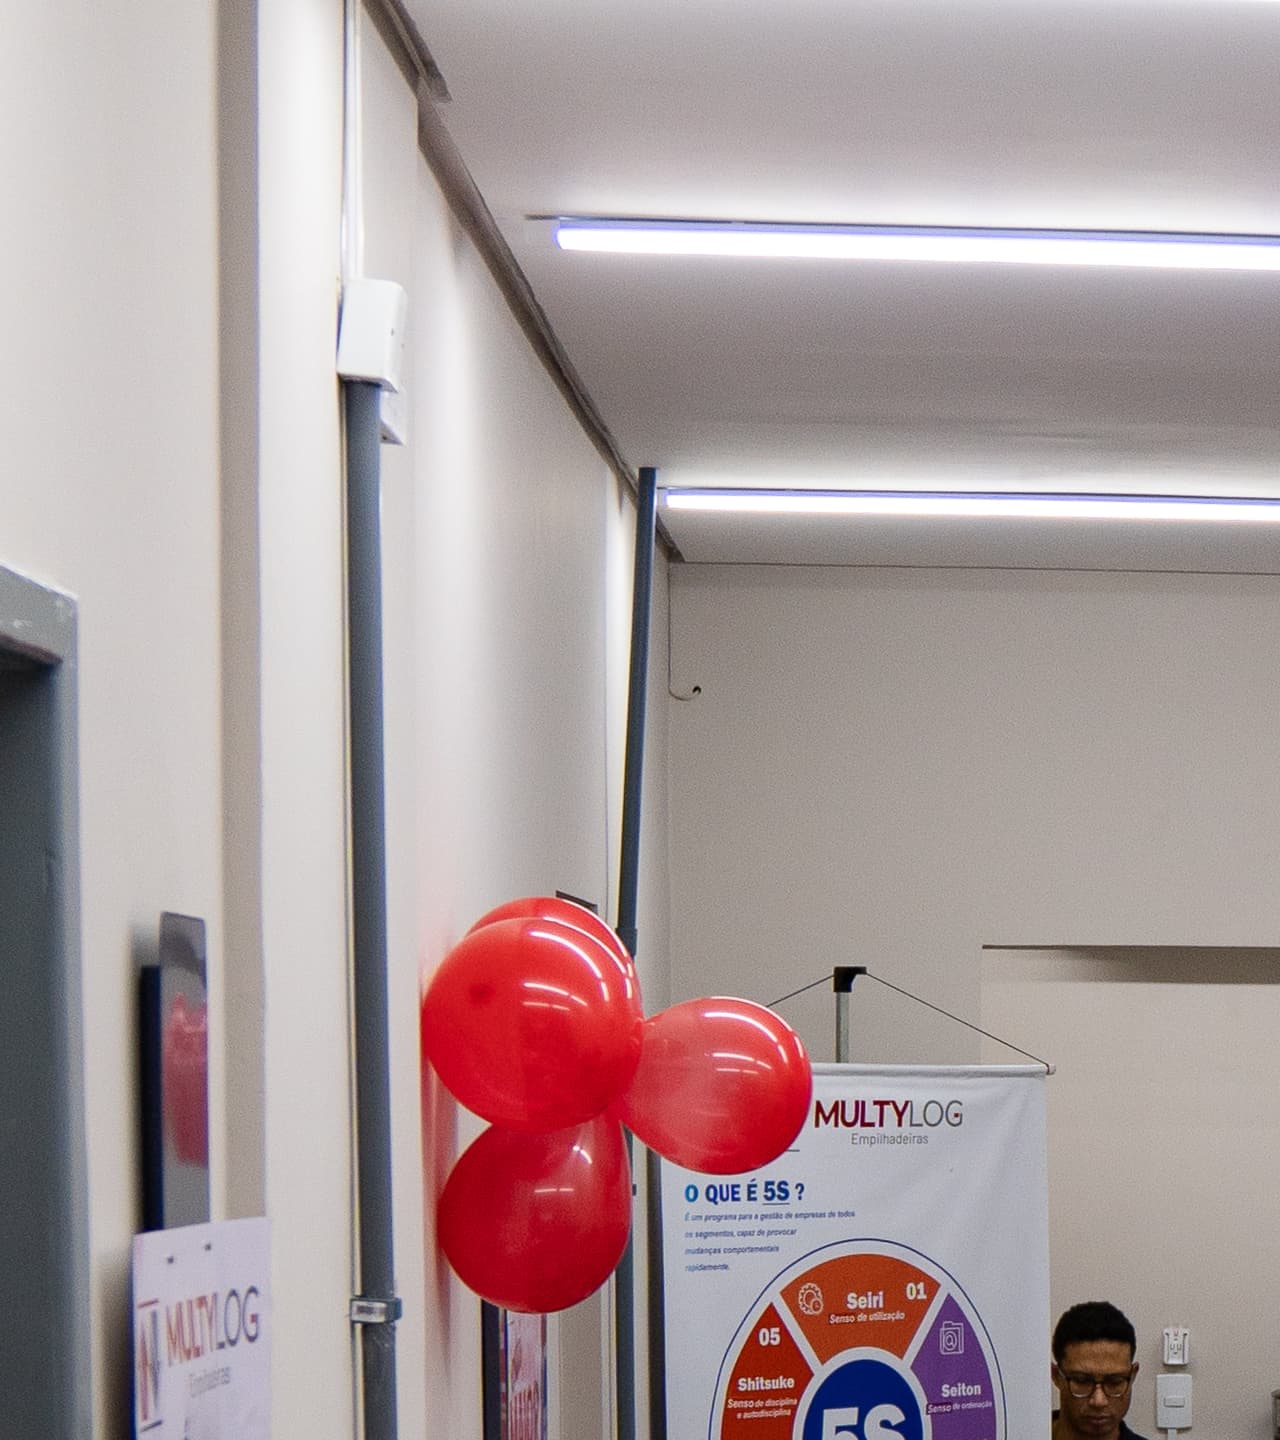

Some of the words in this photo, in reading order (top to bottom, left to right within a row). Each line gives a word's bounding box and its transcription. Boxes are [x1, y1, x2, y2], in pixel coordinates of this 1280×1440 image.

[814, 1100, 964, 1128] MULTYLOG
[851, 1132, 929, 1147] Empilhadeiras
[684, 1184, 699, 1203] O
[705, 1183, 741, 1205] QUE
[746, 1178, 757, 1202] É
[763, 1180, 790, 1203] 5S
[795, 1182, 805, 1200] ?
[846, 1290, 884, 1310] Seiri
[905, 1281, 928, 1301] 01
[165, 1286, 260, 1367] MULTYLOG
[829, 1313, 856, 1325] Senso
[857, 1312, 868, 1322] de
[758, 1327, 781, 1346] 05
[737, 1375, 796, 1392] Shitsuke
[941, 1382, 982, 1398] Seiton
[727, 1398, 754, 1409] Senso
